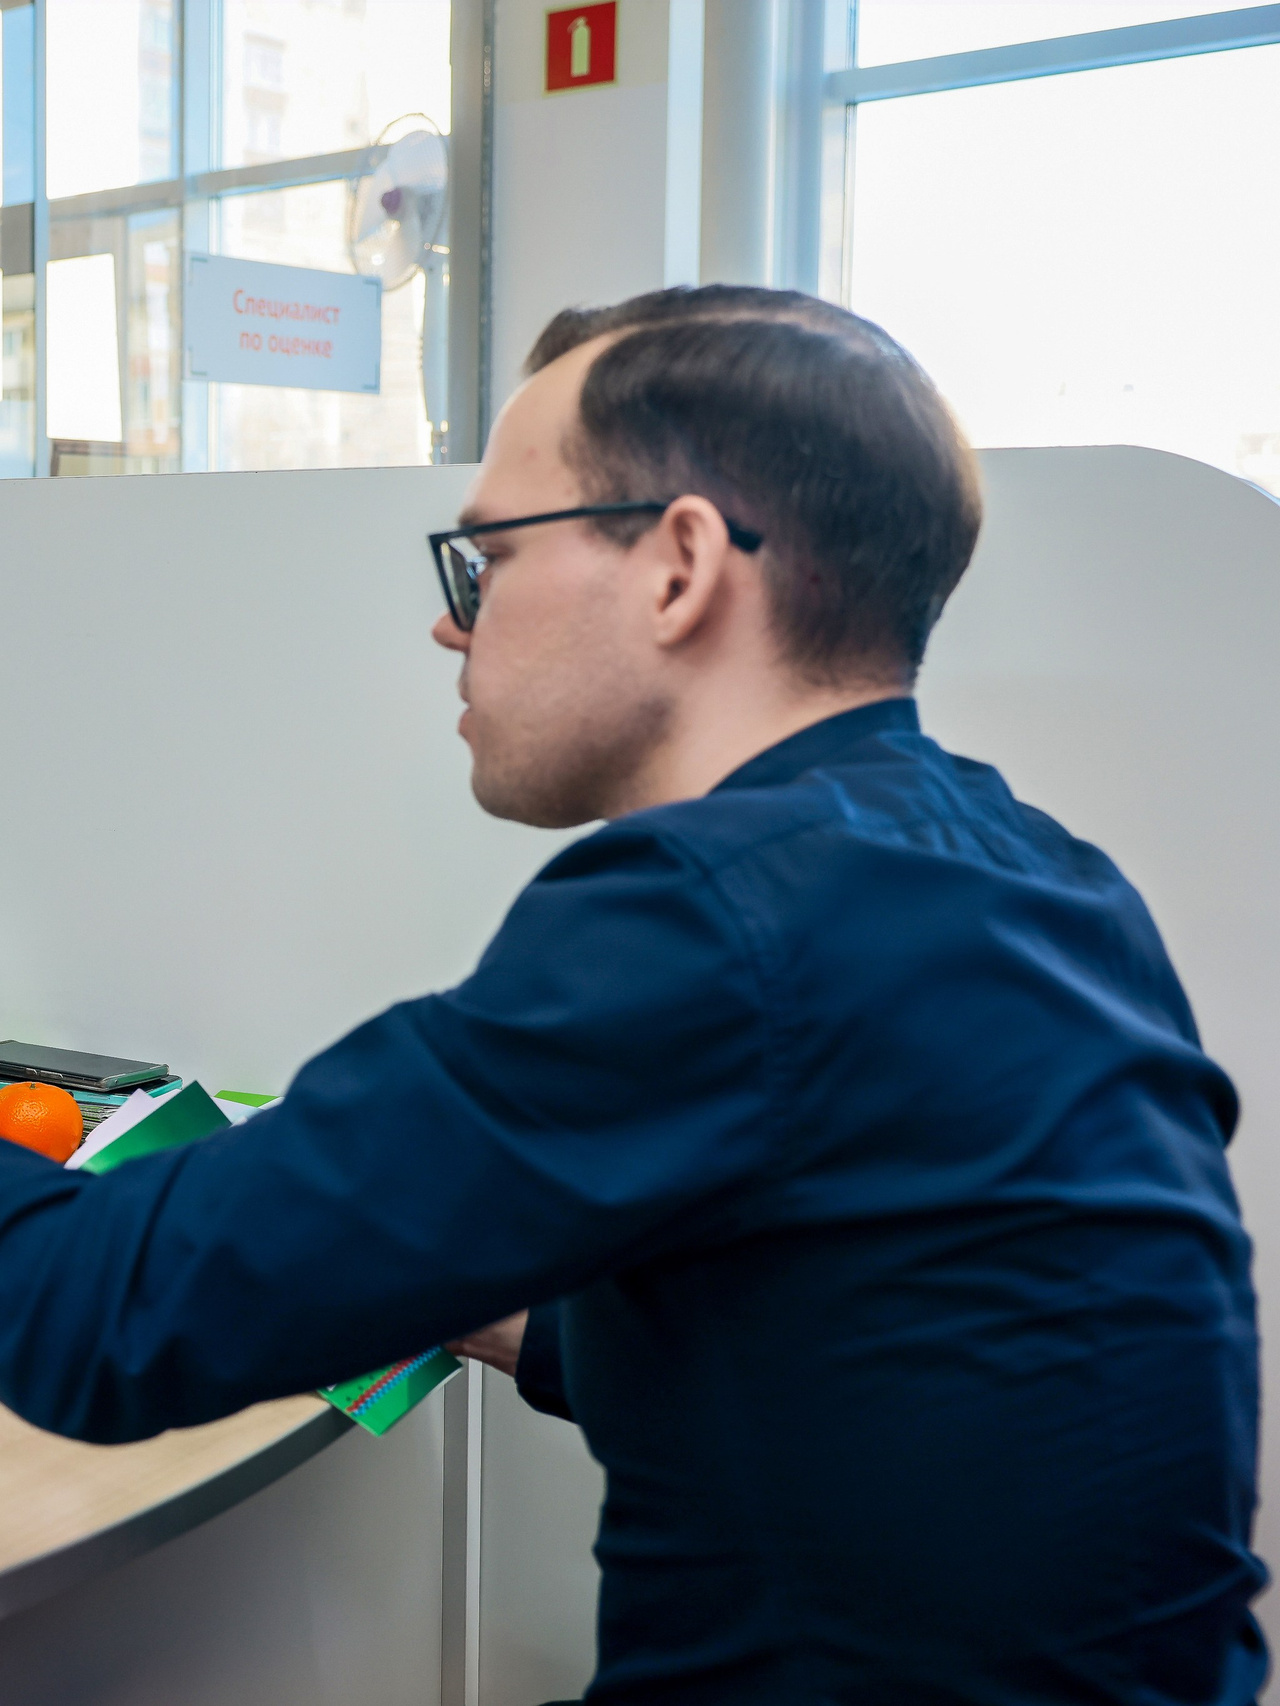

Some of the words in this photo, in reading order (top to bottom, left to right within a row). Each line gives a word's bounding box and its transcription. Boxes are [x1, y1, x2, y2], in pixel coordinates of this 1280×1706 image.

[233, 289, 341, 326] Специалист
[240, 332, 263, 353] по
[268, 334, 333, 359] оценке
